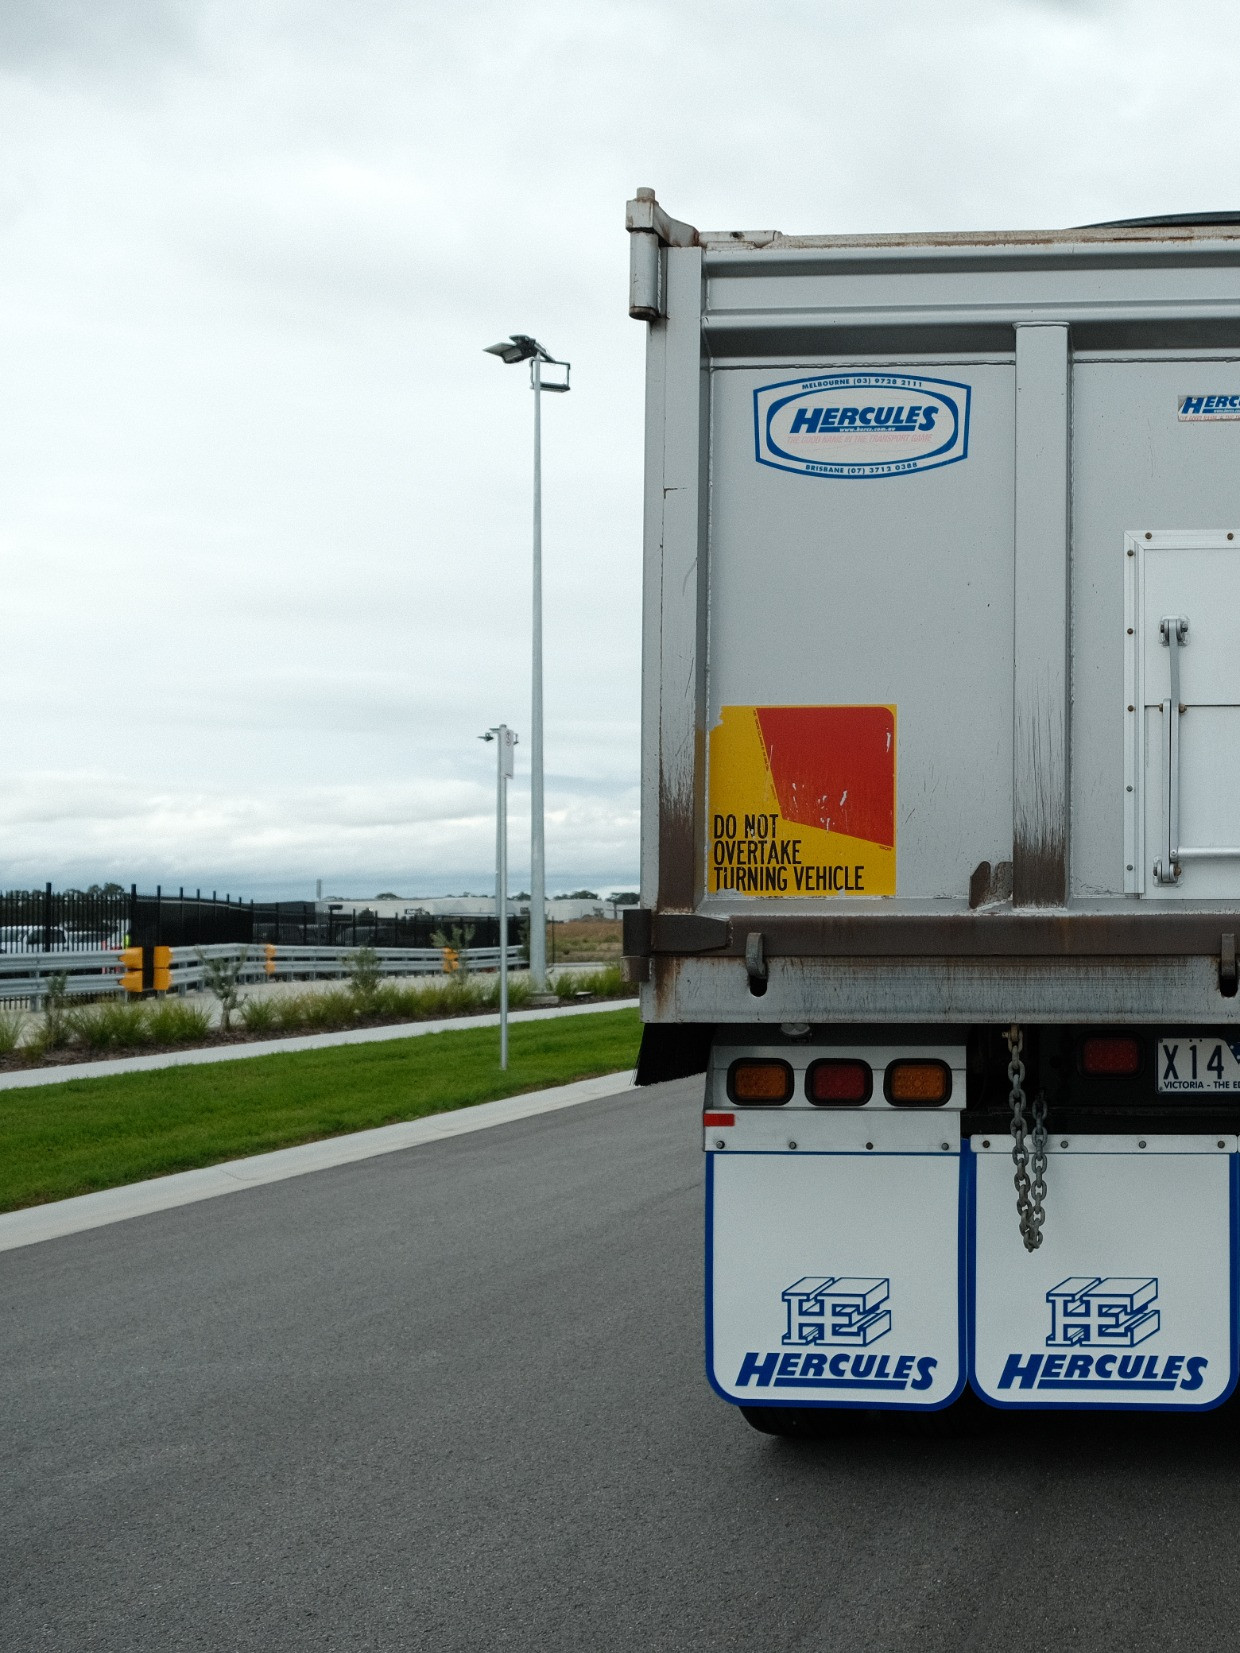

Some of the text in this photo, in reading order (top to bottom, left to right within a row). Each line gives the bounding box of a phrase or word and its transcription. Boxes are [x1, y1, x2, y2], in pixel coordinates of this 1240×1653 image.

[802, 379, 850, 390] MELBOURNE
[901, 379, 922, 387] 2111
[790, 406, 939, 433] HERCULES
[787, 434, 800, 444] THE
[822, 434, 843, 444] NAME
[854, 434, 868, 443] THE
[869, 434, 910, 443] TRANSPORT
[911, 433, 933, 443] GAME
[805, 464, 844, 474] BRISBANE
[895, 462, 918, 471] 0388
[713, 814, 779, 839] DO NOT
[713, 840, 802, 865] OVERTAKE
[714, 866, 865, 891] TURNING VEHICLE
[1163, 1044, 1225, 1080] X14
[1163, 1080, 1204, 1089] VICTORIA
[1213, 1080, 1230, 1089] THE
[735, 1352, 938, 1391] HERCULES
[997, 1353, 1209, 1391] HERCULES
